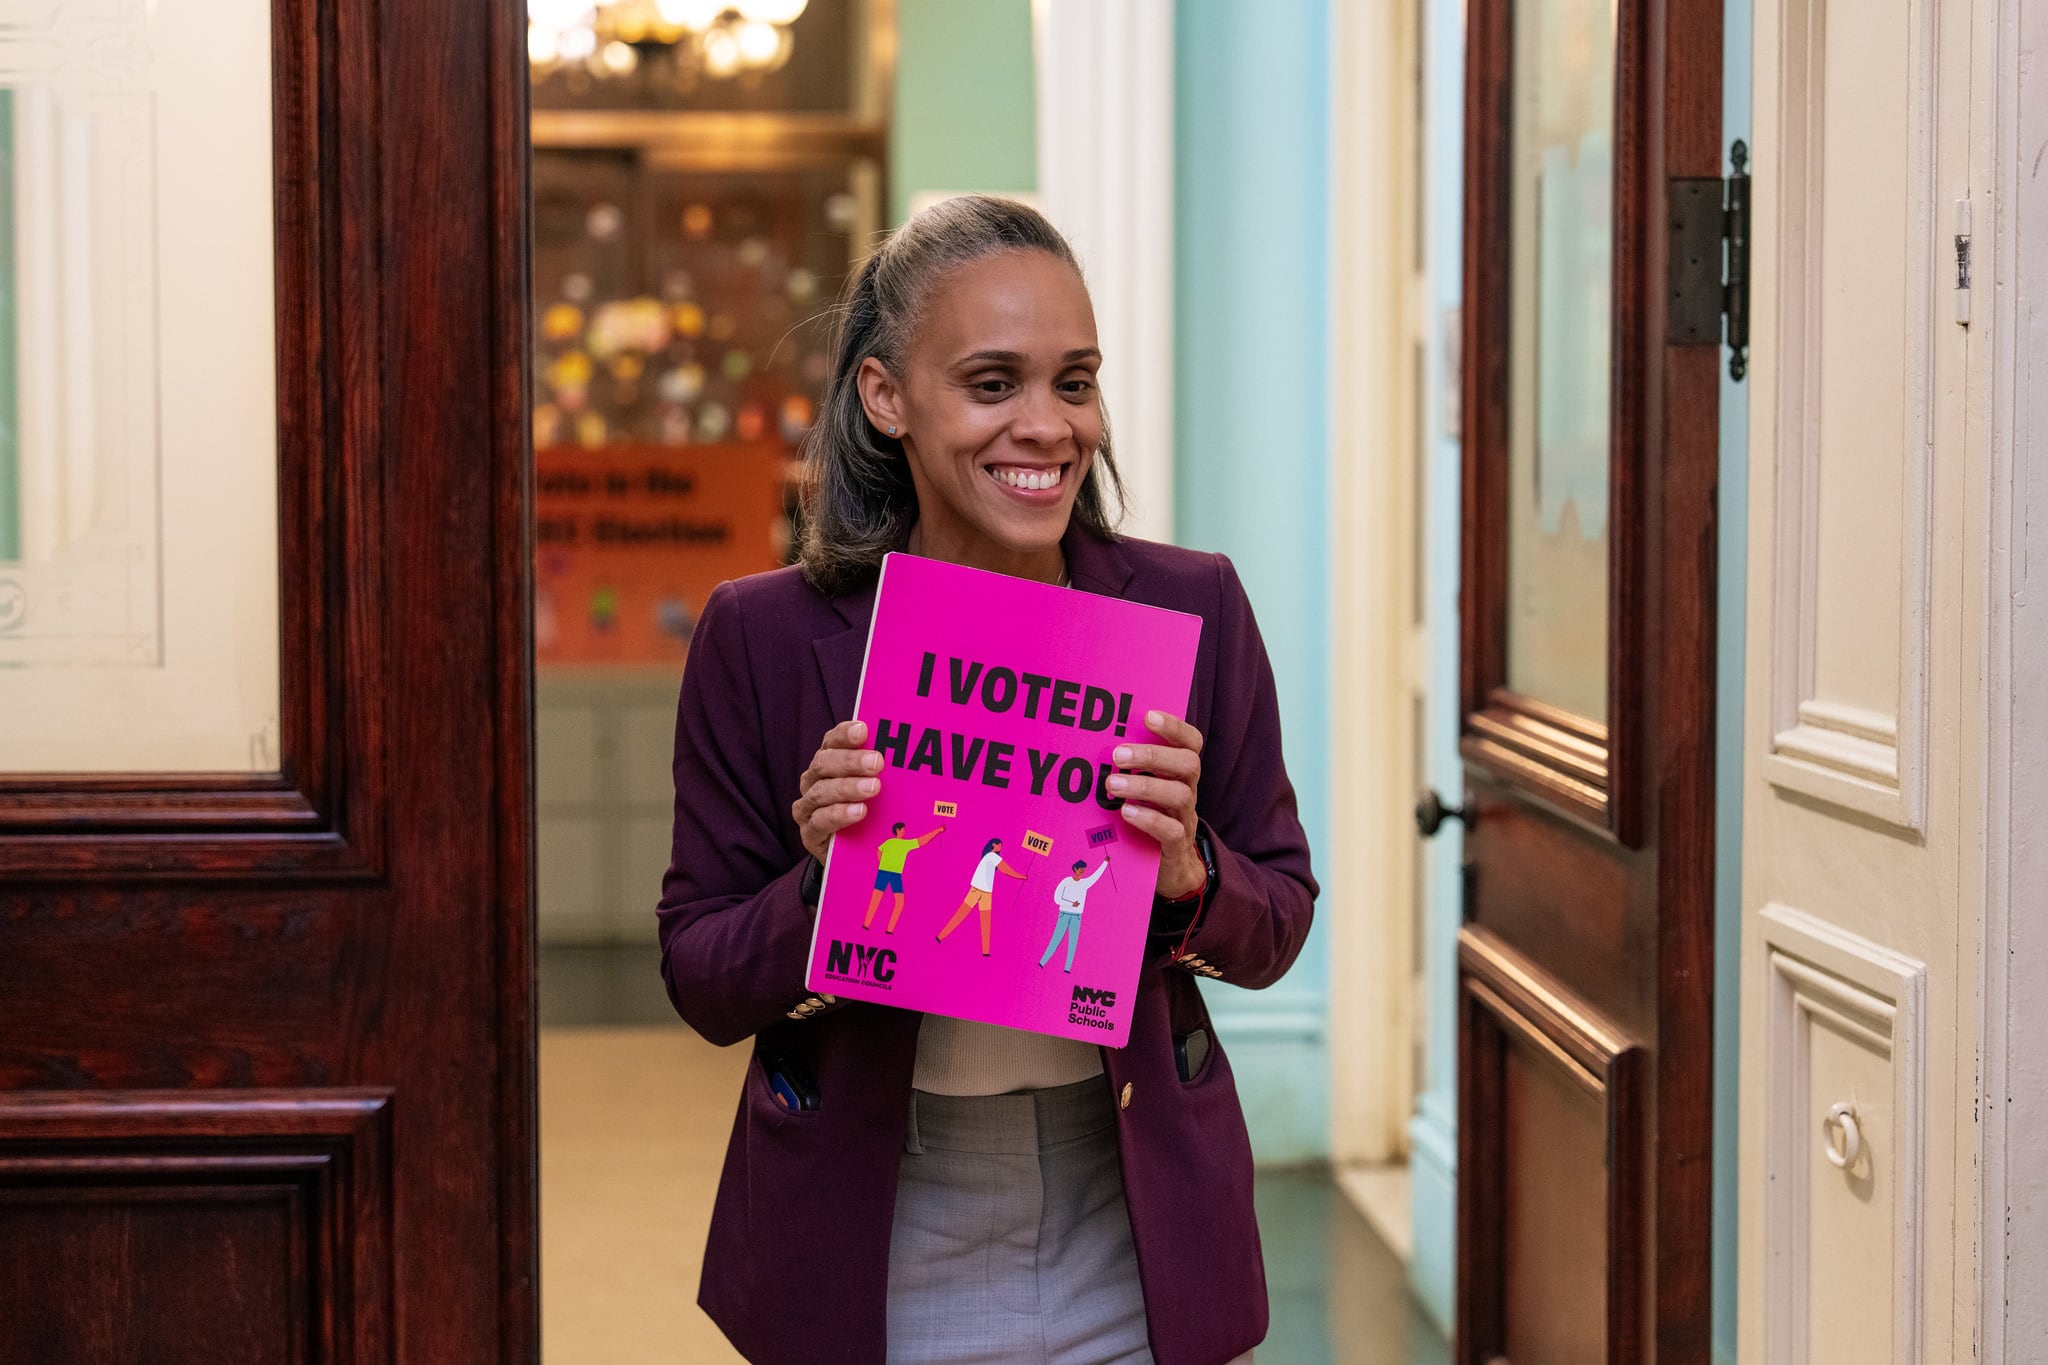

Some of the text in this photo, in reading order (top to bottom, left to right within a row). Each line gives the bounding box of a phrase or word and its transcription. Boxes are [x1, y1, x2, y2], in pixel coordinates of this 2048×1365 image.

[916, 651, 1133, 738] I VOTED!
[874, 718, 1156, 811] HAVE YOU
[937, 804, 954, 815] VOTE
[1027, 835, 1049, 852] VOTE
[1091, 828, 1113, 844] VOTE
[826, 939, 897, 982] NYC
[824, 973, 893, 991] EDUCATION COUNCILS
[1071, 985, 1117, 1008] NYC
[1069, 1001, 1107, 1018] Public
[1067, 1013, 1115, 1031] Schools
